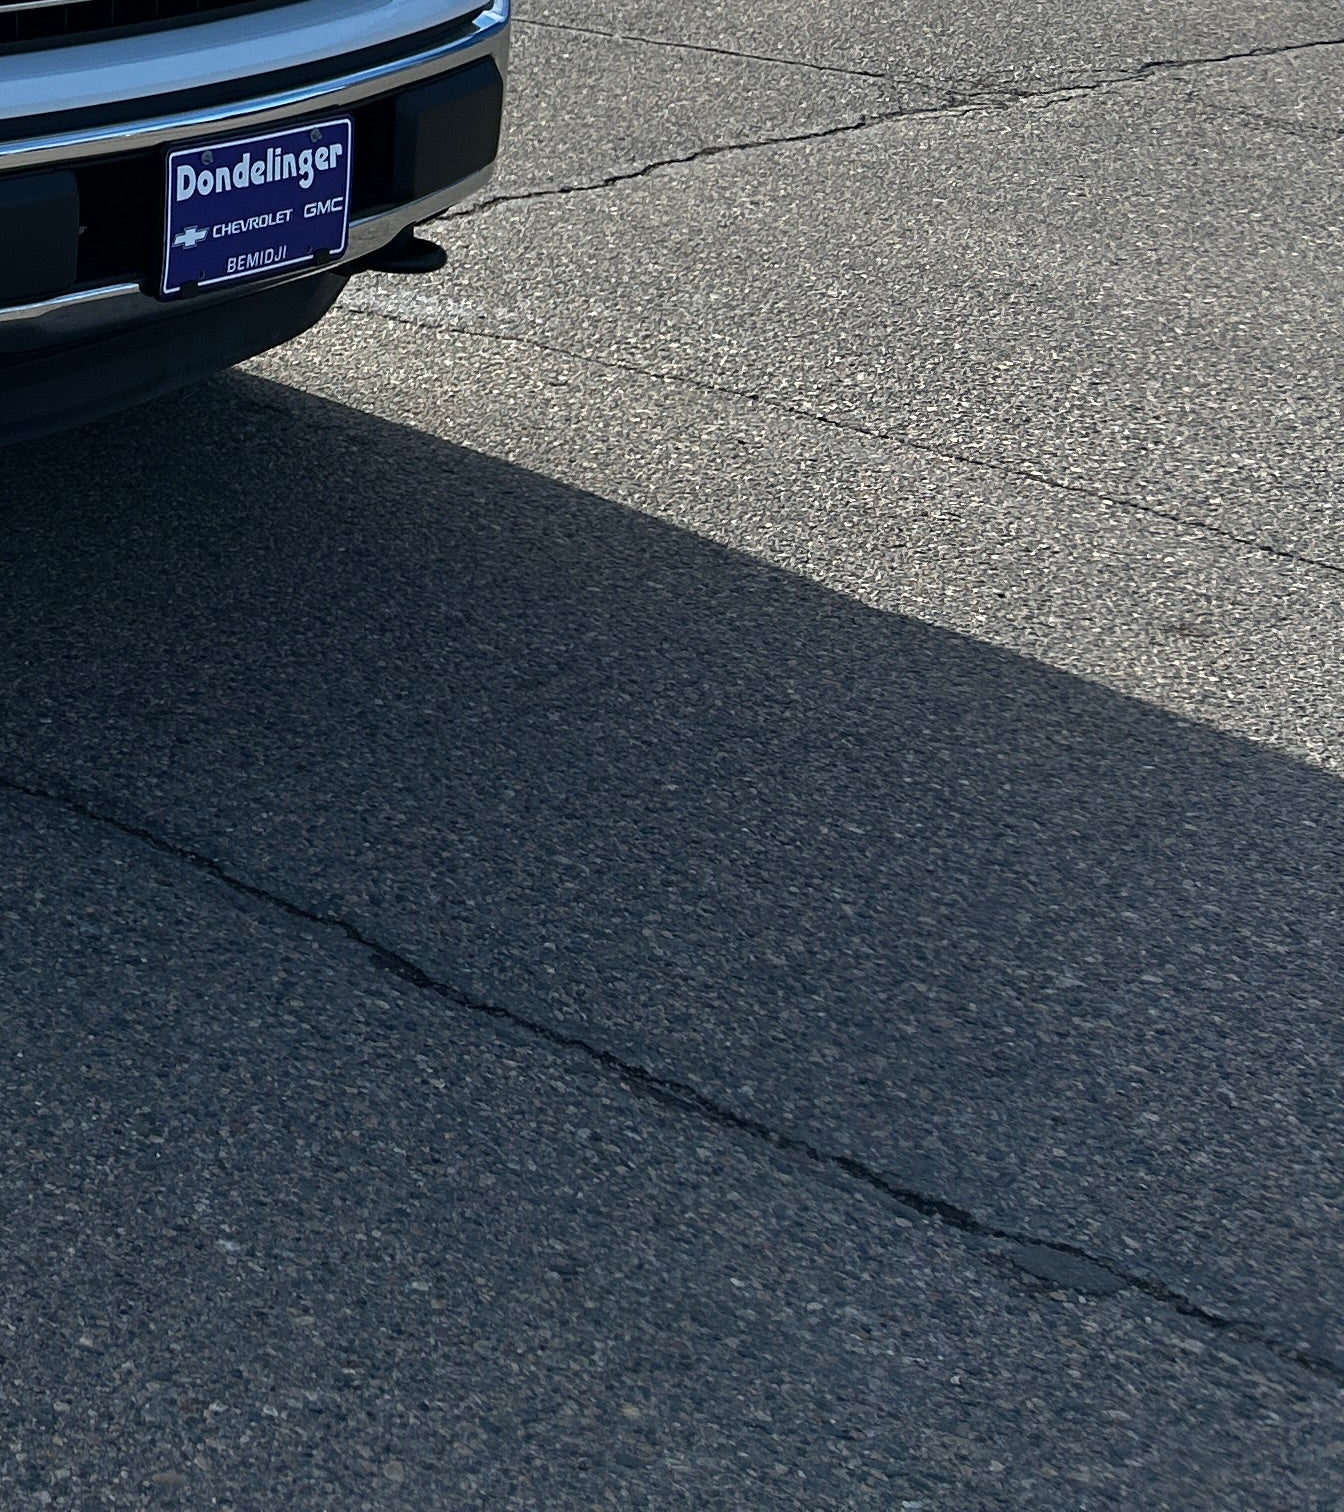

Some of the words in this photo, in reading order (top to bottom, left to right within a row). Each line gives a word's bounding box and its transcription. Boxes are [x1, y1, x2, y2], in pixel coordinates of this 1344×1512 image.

[176, 143, 343, 201] Dondelinger
[212, 208, 294, 238] CHEVROLET
[303, 196, 344, 219] GMC
[226, 244, 288, 274] BEMIDJI
